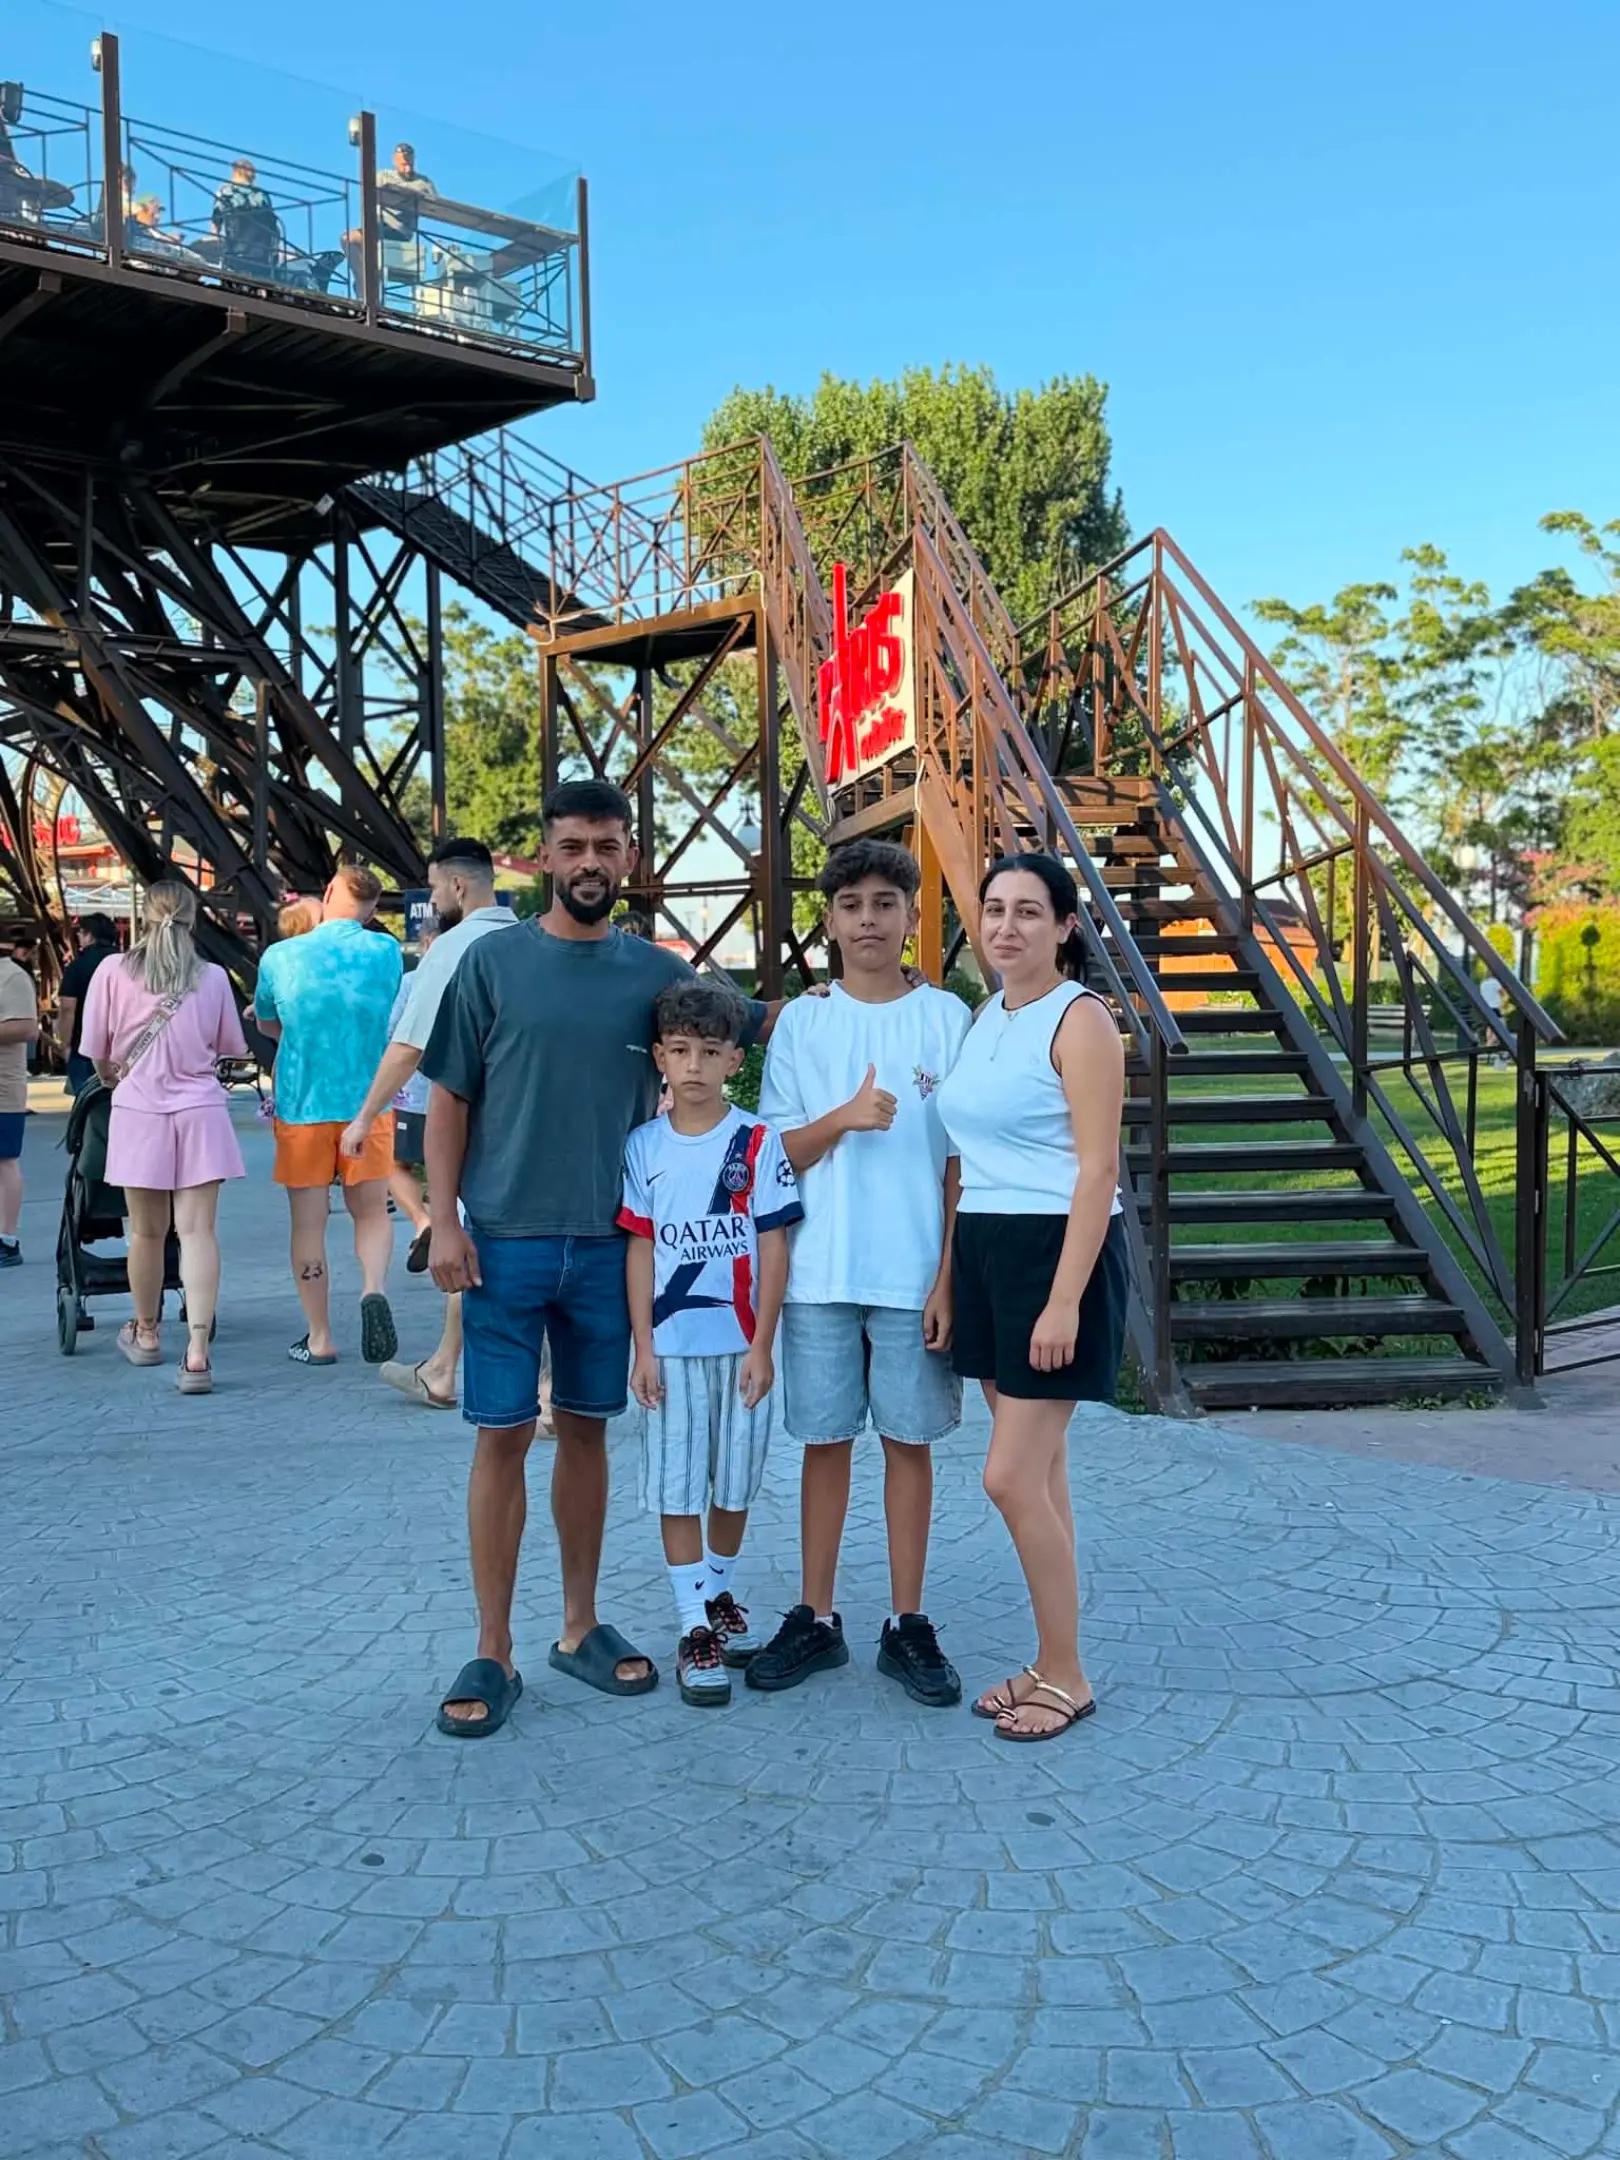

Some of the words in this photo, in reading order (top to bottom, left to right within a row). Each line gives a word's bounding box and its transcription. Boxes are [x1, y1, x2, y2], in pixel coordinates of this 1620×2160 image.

[409, 902, 433, 919] ATM
[659, 1215, 747, 1250] QATAR
[680, 1239, 749, 1261] AIRWAYS
